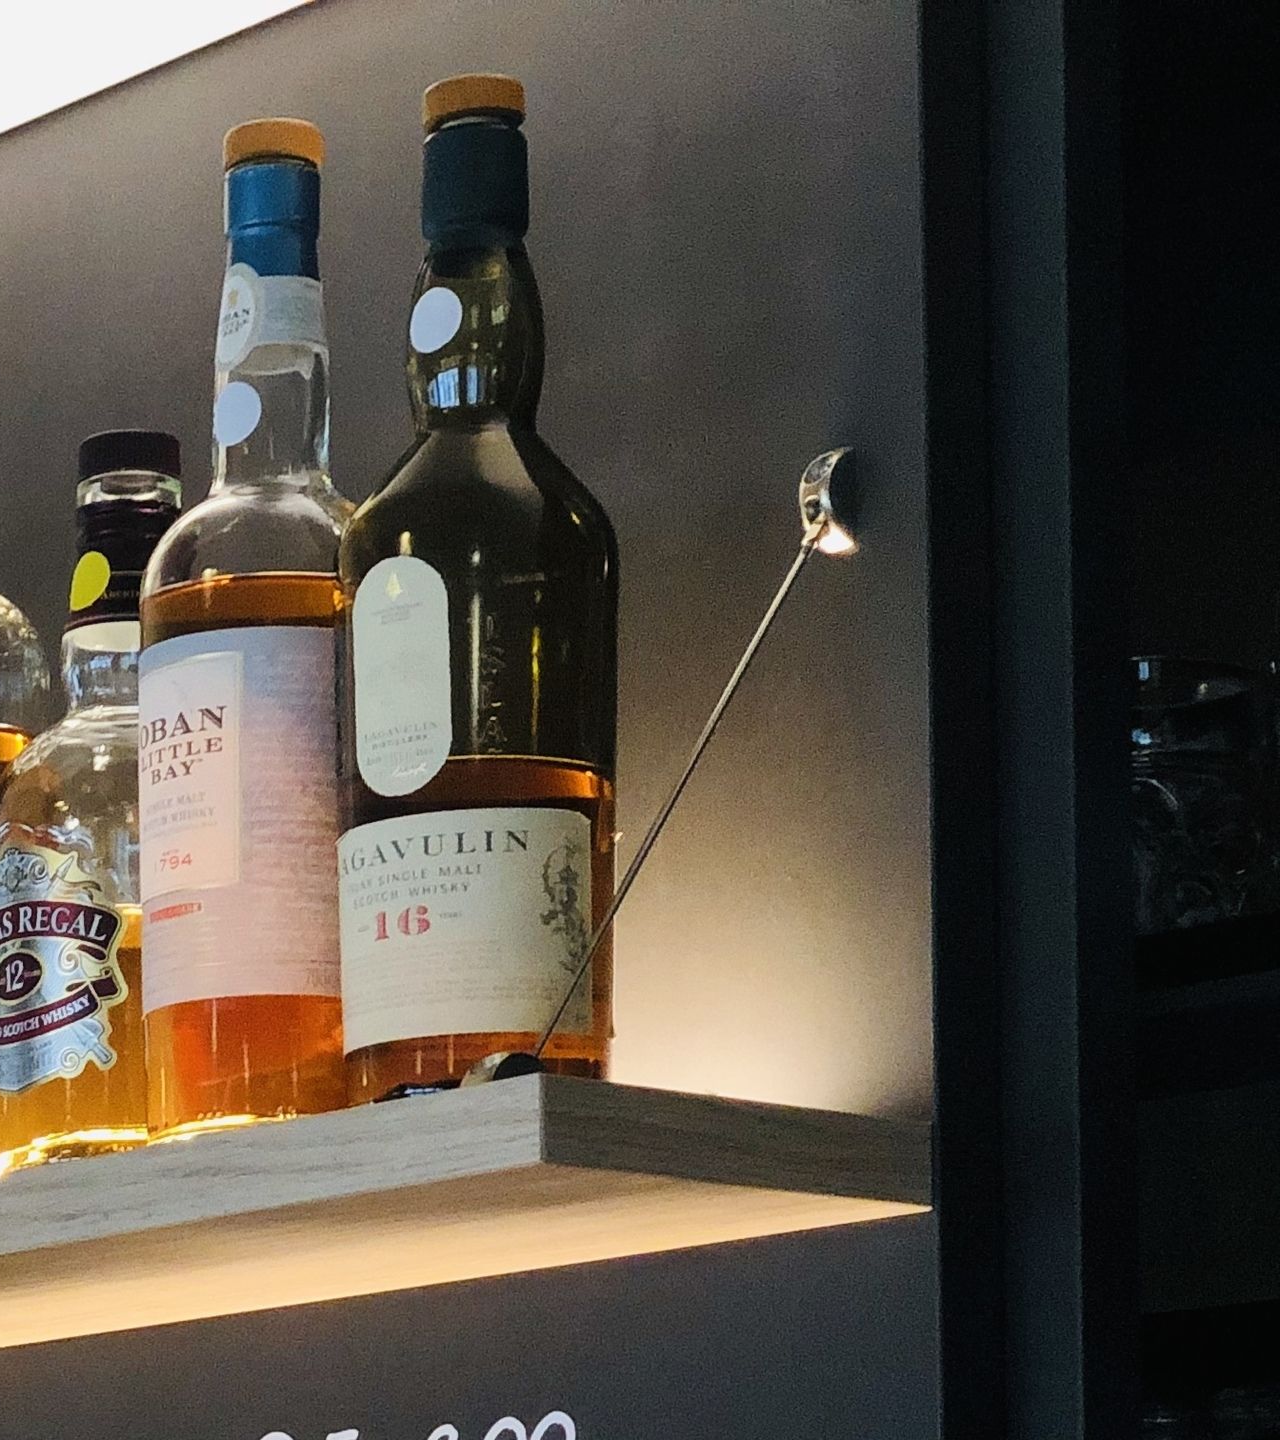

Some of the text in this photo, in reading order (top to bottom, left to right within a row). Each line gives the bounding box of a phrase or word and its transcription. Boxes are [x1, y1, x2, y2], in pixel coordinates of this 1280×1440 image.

[140, 705, 227, 750] OBAN
[141, 737, 223, 773] LITTLE
[151, 759, 195, 785] BAY
[378, 863, 481, 887] SINGLE MALT
[354, 882, 471, 910] SCOTCH WHISKY
[18, 906, 107, 941] REGAL
[375, 905, 431, 942] 16
[5, 960, 24, 992] 12
[3, 994, 91, 1038] SCOTCH WHISKY
